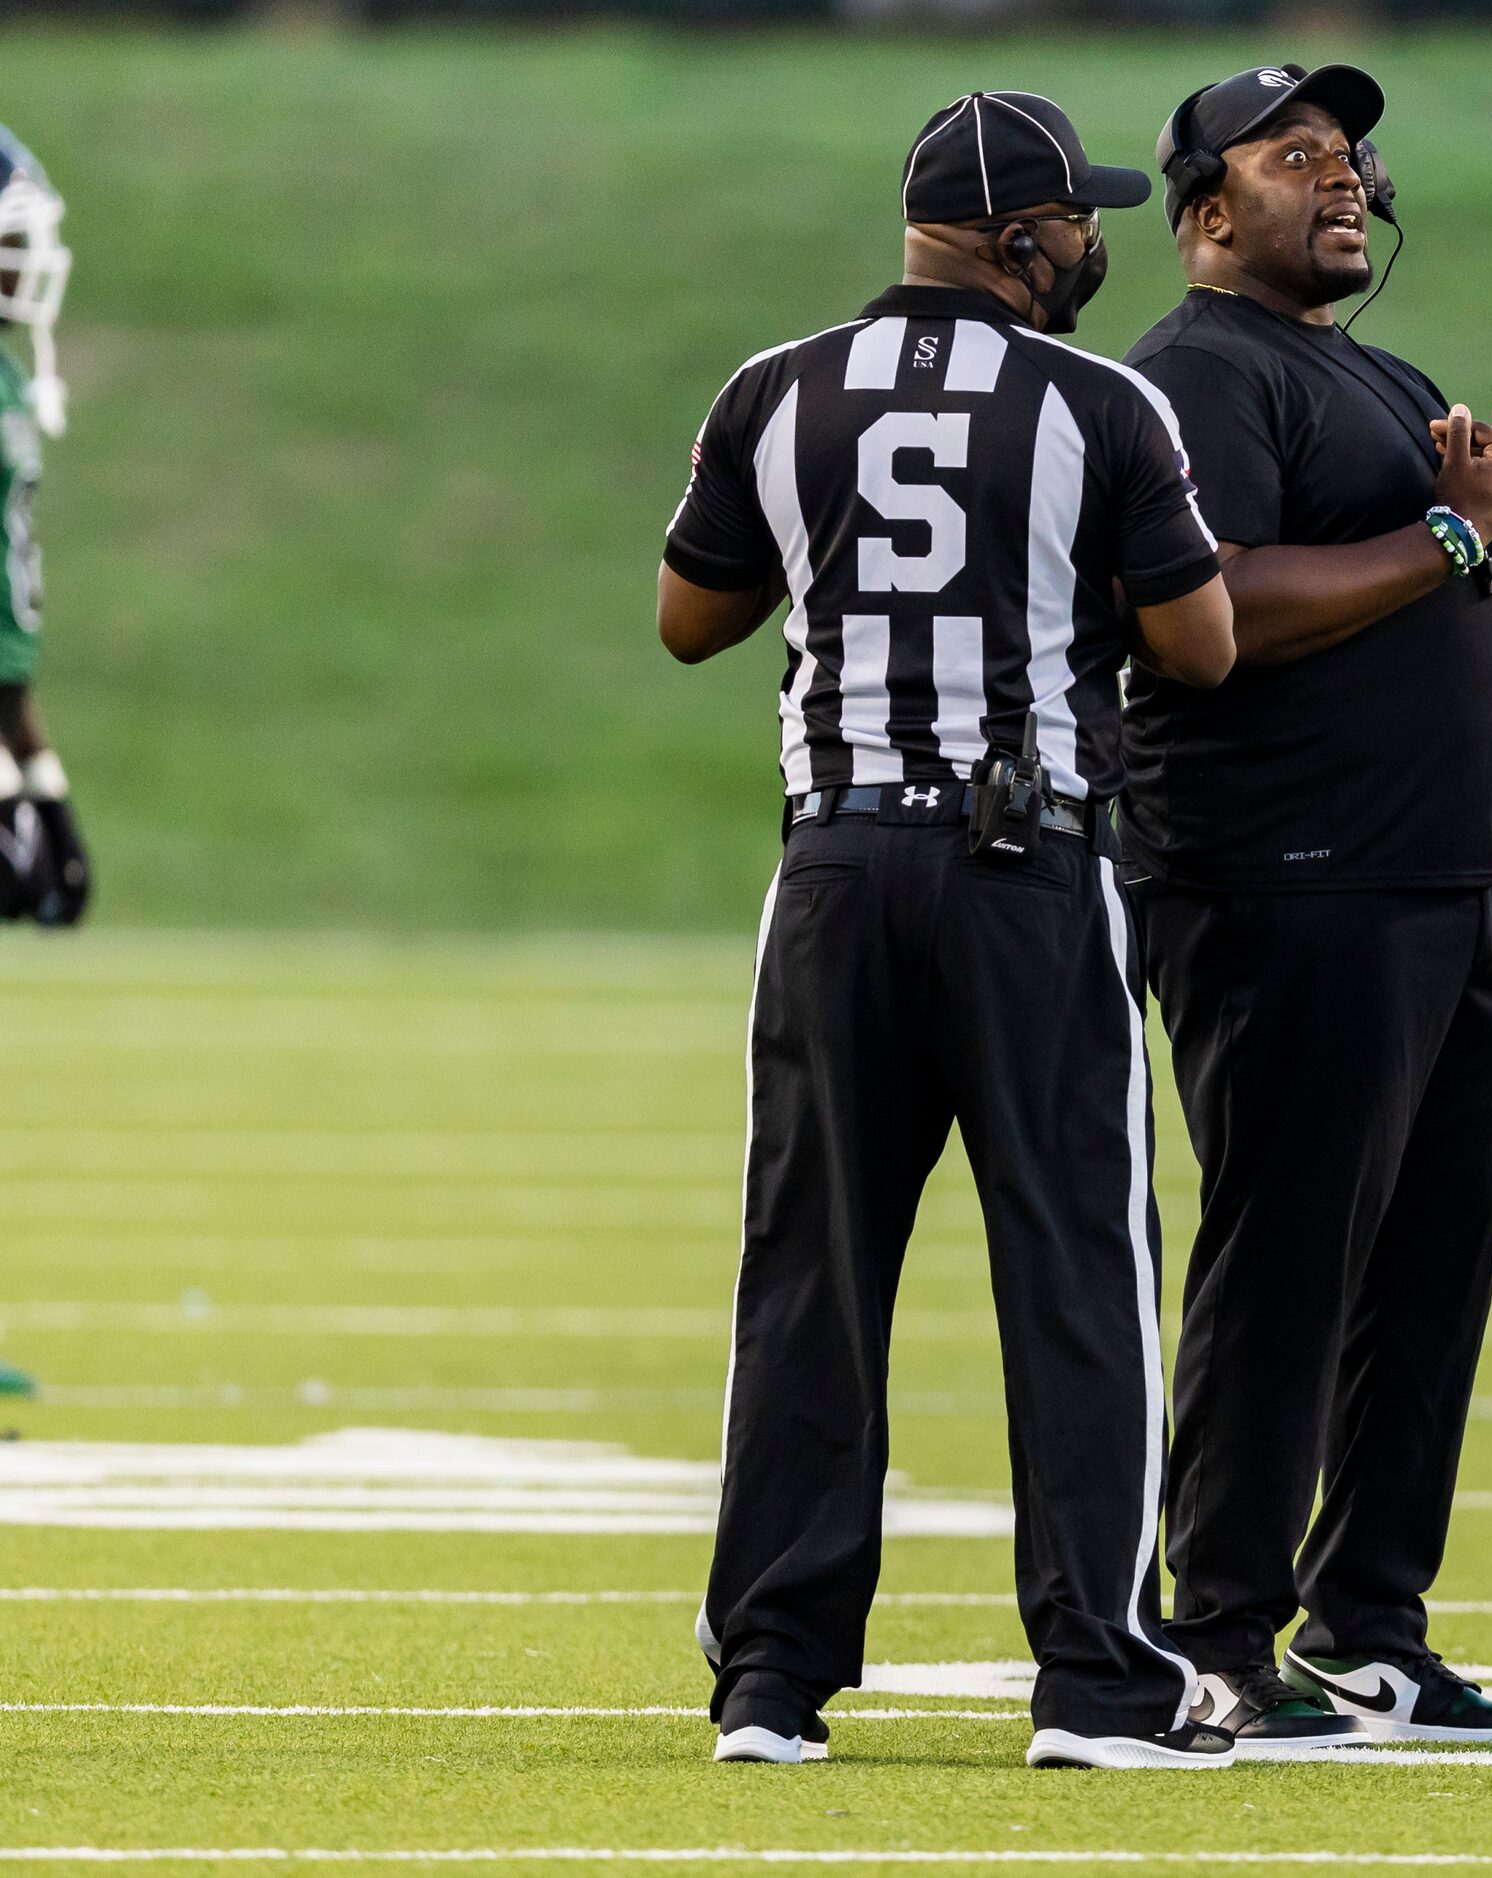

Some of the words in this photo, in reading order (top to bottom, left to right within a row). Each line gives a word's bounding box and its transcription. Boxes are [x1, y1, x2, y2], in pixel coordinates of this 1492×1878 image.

[913, 360, 934, 369] USA
[857, 411, 971, 593] S
[1283, 849, 1331, 861] DRI-FIT
